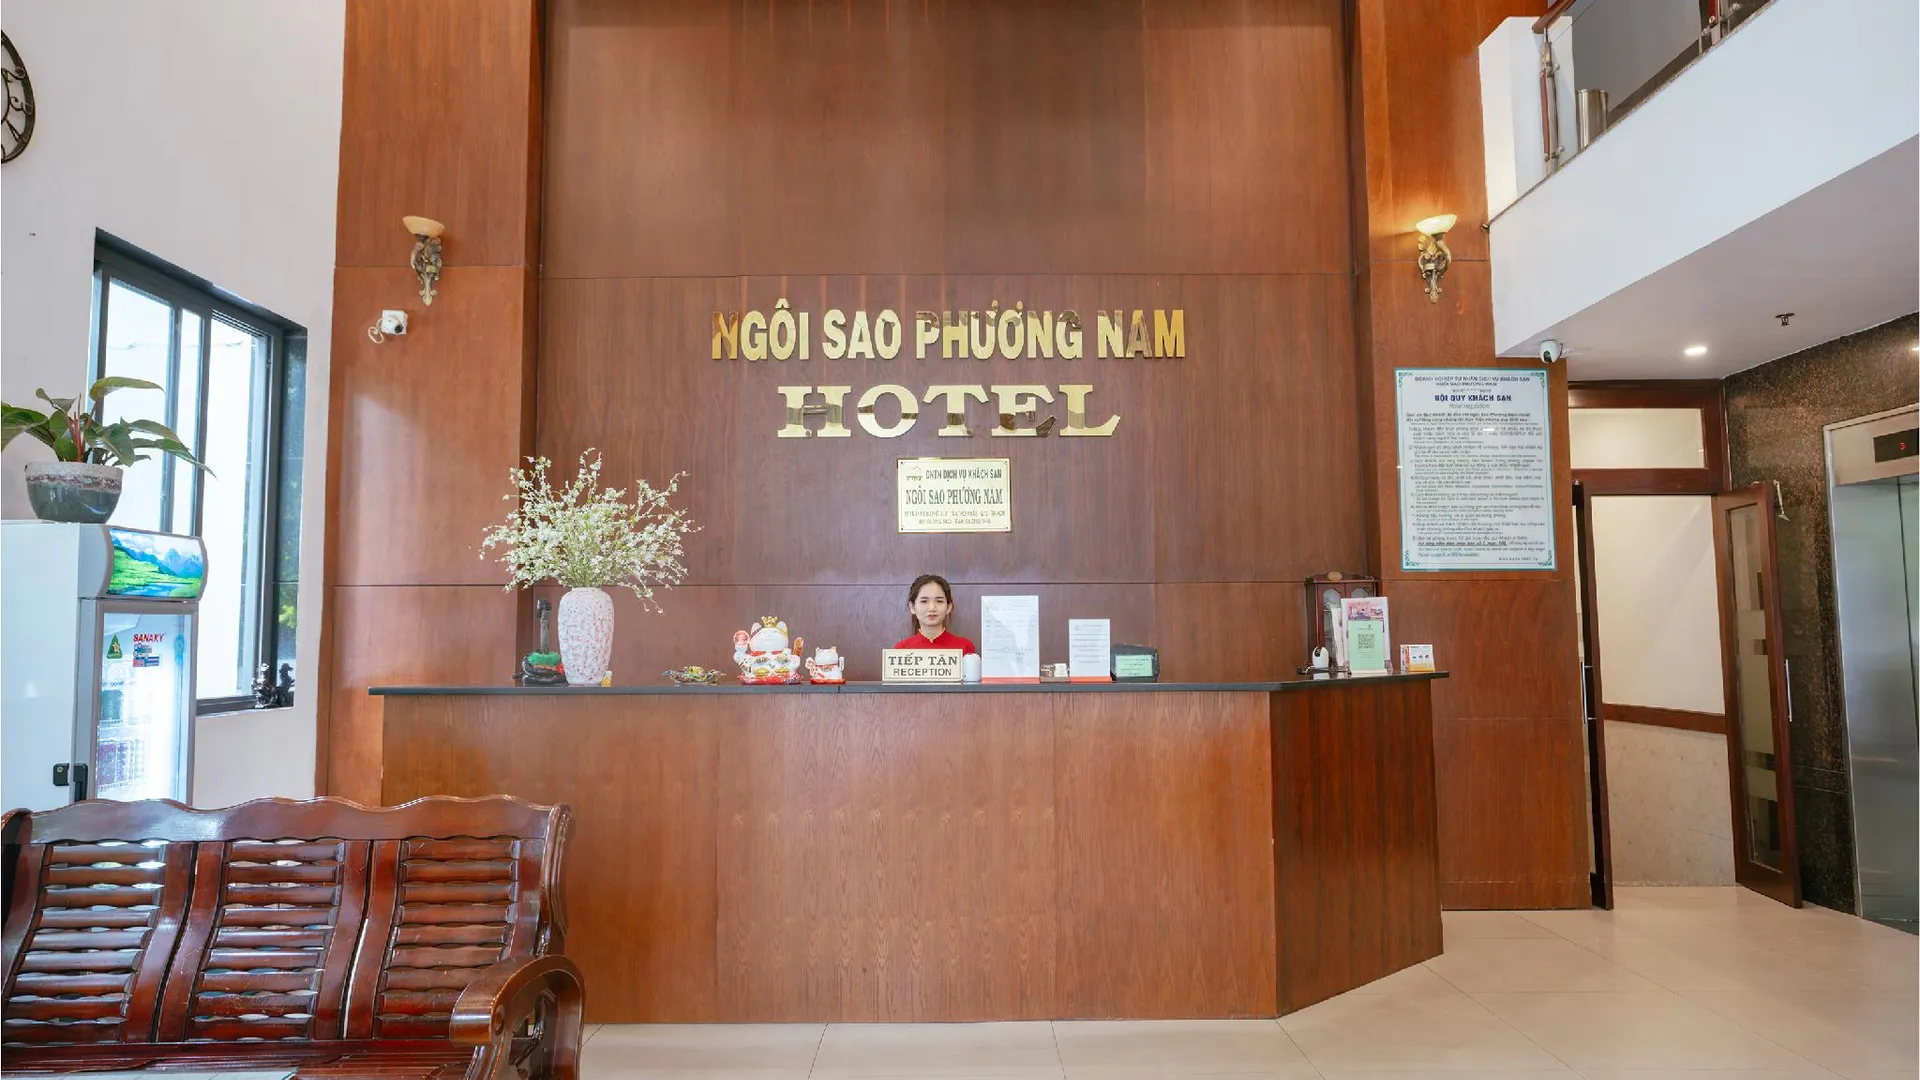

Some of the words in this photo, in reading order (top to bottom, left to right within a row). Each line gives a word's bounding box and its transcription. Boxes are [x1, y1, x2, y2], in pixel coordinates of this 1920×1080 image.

[711, 298, 809, 361] NGÔI
[822, 309, 902, 361] SAO
[916, 300, 1083, 361] PHƯƠNG
[1097, 309, 1186, 360] NAM
[1435, 394, 1448, 403] NỘI
[1451, 394, 1466, 402] QUY
[1468, 393, 1494, 402] KHÁCH
[1497, 395, 1512, 403] SẠN
[777, 384, 1121, 438] HOTEL
[943, 469, 957, 482] DỊCH
[958, 469, 967, 481] VỤ
[967, 468, 989, 479] KHÁCH
[928, 489, 945, 504] SAO
[983, 488, 1003, 504] NAM
[133, 633, 165, 642] SANAKY
[888, 652, 923, 666] TIẾP
[928, 654, 958, 666] TÂN
[893, 668, 951, 676] RECEPTION
